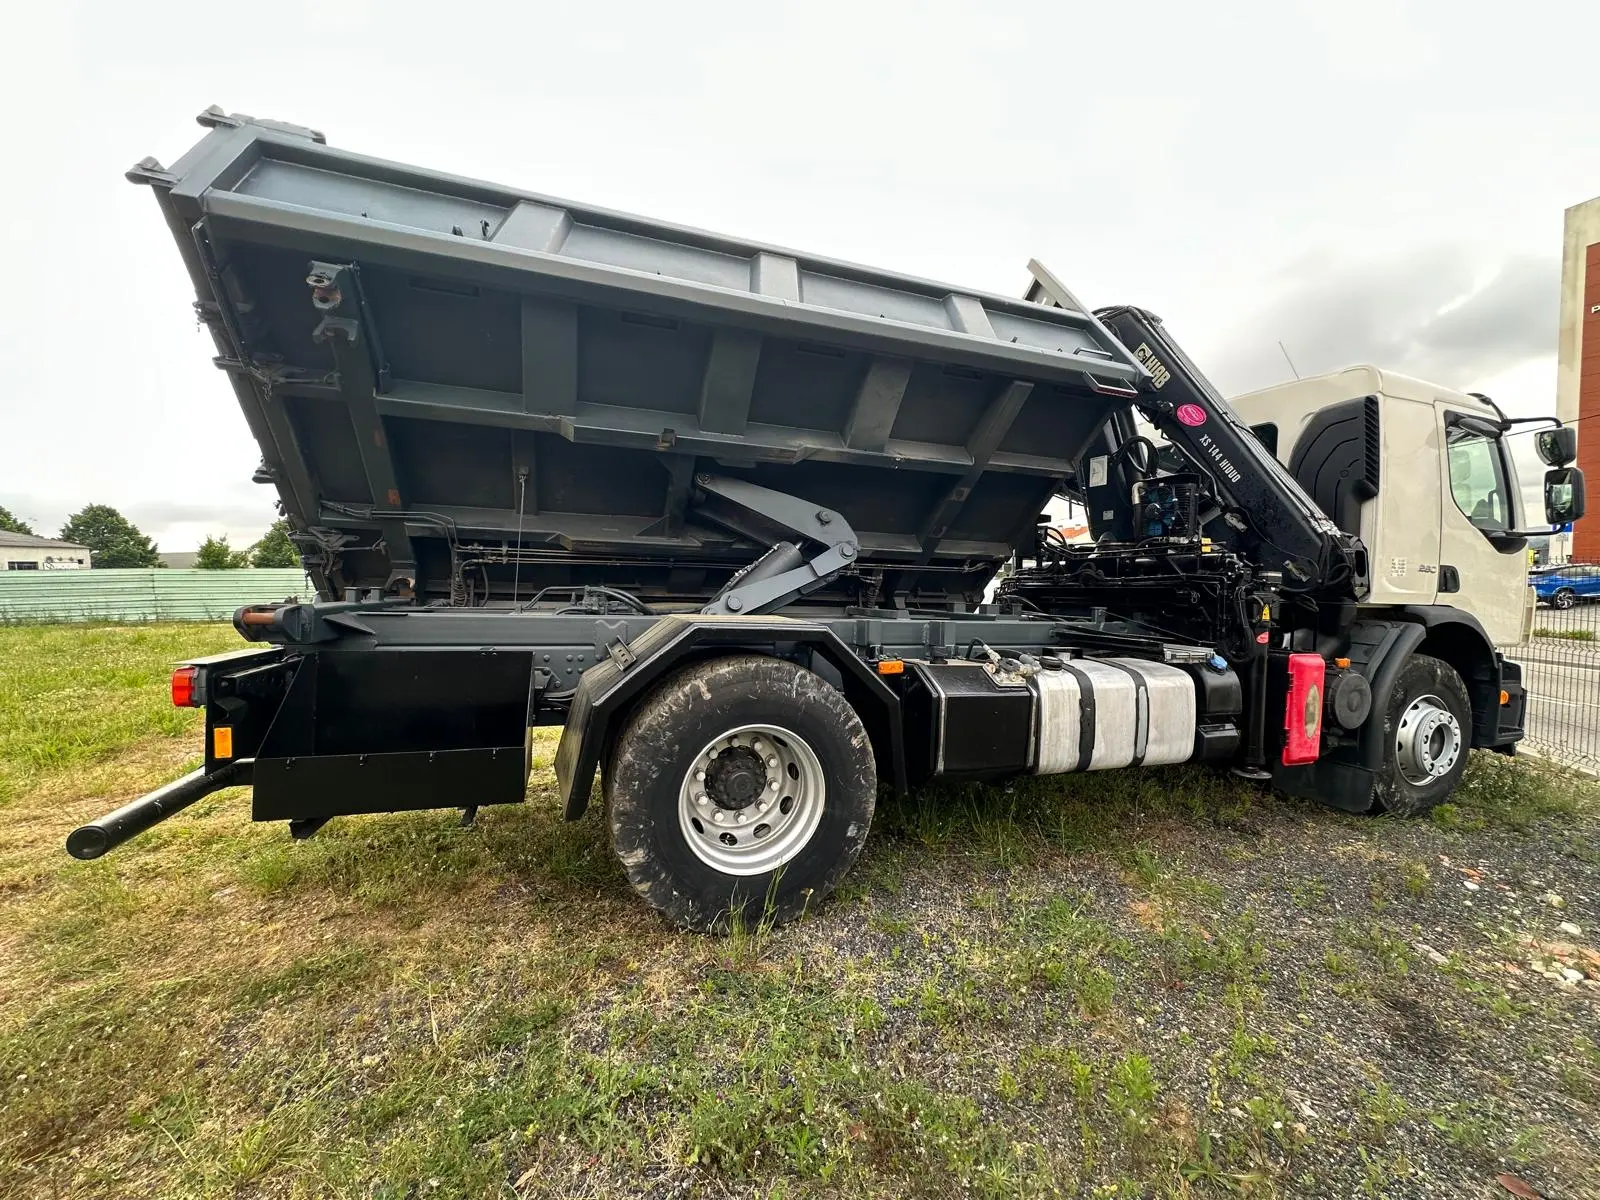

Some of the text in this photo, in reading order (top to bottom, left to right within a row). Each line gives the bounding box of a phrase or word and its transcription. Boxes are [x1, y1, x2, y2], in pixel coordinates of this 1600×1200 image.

[1143, 354, 1171, 389] HIAB
[1200, 433, 1241, 483] XS 144 HIDUO
